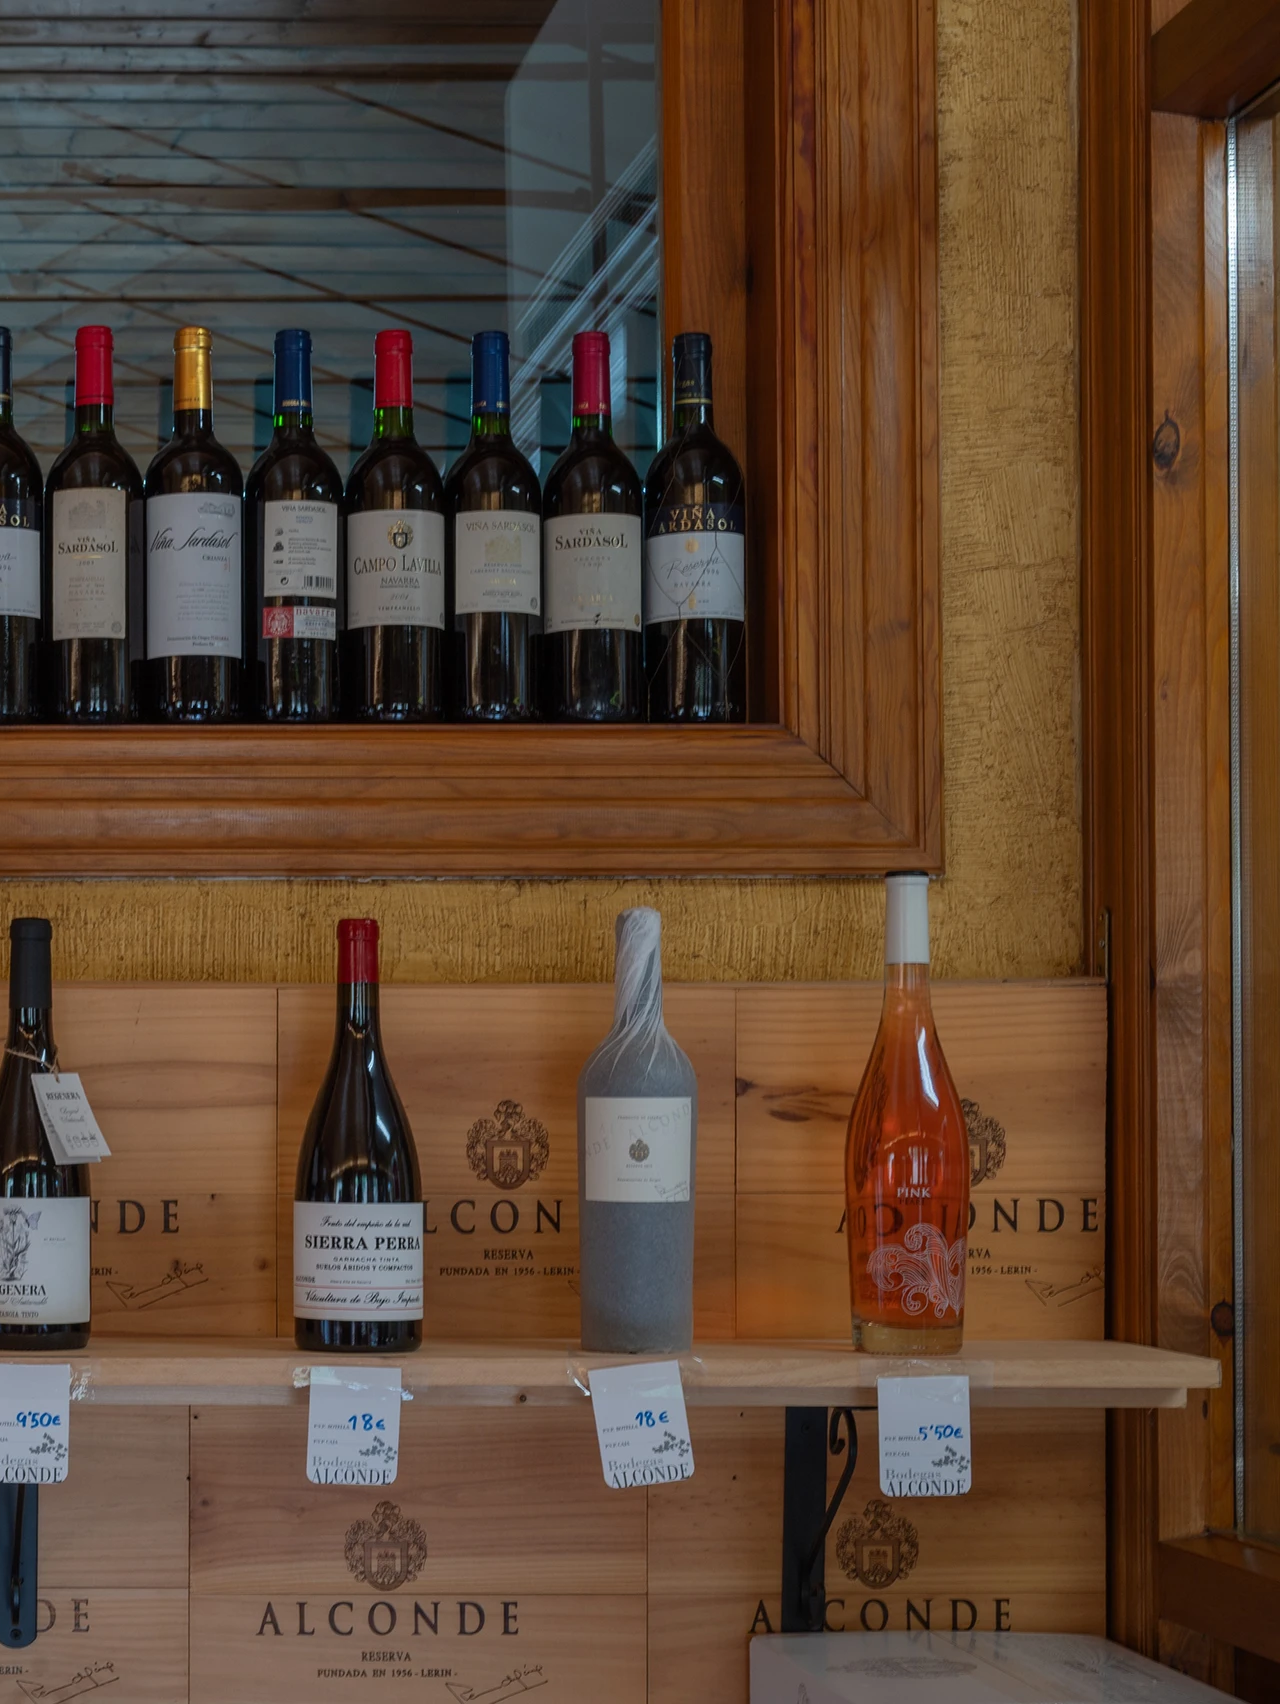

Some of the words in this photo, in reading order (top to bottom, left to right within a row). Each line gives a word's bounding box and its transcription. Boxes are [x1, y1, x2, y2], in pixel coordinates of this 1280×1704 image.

[671, 507, 715, 519] VIÑA
[466, 521, 489, 531] VIÑA
[491, 521, 536, 534] SARDASOL
[579, 528, 602, 536] VIÑA
[173, 526, 237, 551] Sardasol
[555, 533, 628, 550] SARDASOL
[58, 540, 118, 555] SARDASOL
[354, 555, 397, 575] CAMPO
[401, 554, 441, 576] LAVILLA
[381, 576, 419, 585] NAVARRA
[897, 1187, 931, 1198] PINK
[305, 1234, 368, 1250] SIERRA
[374, 1234, 420, 1250] PERRA
[483, 1249, 534, 1260] RESERVA
[91, 1267, 112, 1277] ERIN
[439, 1266, 489, 1276] FUNDADA
[494, 1266, 508, 1276] EN
[513, 1266, 535, 1276] 1956
[543, 1267, 574, 1276] LERIN
[971, 1266, 992, 1275] 1956
[1000, 1266, 1032, 1275] LERIN
[312, 1456, 368, 1469] Bodegas
[607, 1456, 664, 1472] Bodegas
[313, 1468, 392, 1485] ALCONDE
[611, 1464, 690, 1489] ALCONDE
[885, 1468, 941, 1481] Bodegas
[886, 1479, 967, 1497] ALCONDE
[255, 1600, 520, 1636] ALCONDE
[749, 1599, 1013, 1633] ACONDE
[361, 1651, 412, 1662] RESERVA
[317, 1668, 368, 1678] FUNDADA
[372, 1668, 386, 1678] EN
[391, 1668, 412, 1678] 1956
[420, 1668, 452, 1678] LERIN
